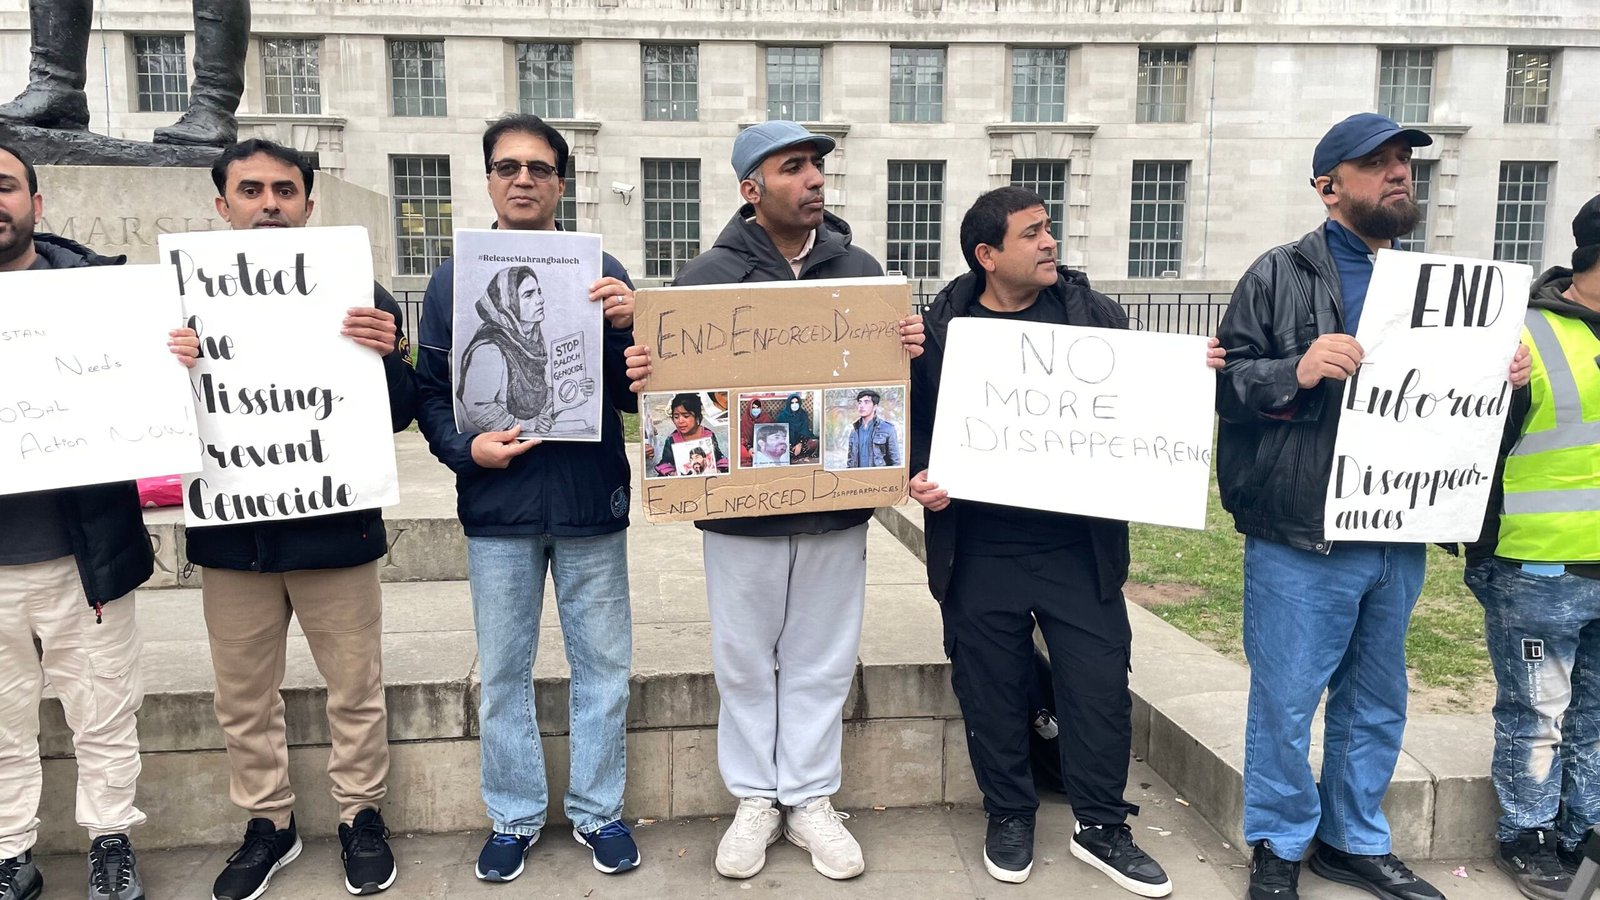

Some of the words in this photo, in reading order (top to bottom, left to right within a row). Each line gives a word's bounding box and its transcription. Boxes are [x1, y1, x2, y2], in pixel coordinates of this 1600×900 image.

[39, 216, 219, 246] MARSH
[169, 249, 317, 298] Protect
[478, 254, 580, 265] #ReleaseMahrangbaloch
[1410, 263, 1504, 328] END
[0, 329, 47, 341] STAN
[186, 315, 236, 360] he
[555, 339, 580, 357] STOP
[655, 309, 728, 360] END
[730, 305, 833, 356] ENFORCED
[54, 353, 123, 376] Needs
[553, 353, 581, 369] BALOCH
[553, 363, 584, 381] GENOCIDE
[1020, 329, 1116, 385] NO
[0, 400, 70, 423] OBAL
[985, 380, 1119, 419] MORE
[1345, 362, 1508, 423] Enforced
[20, 432, 88, 460] Action
[199, 429, 330, 469] revent
[188, 475, 358, 522] Genocide
[646, 484, 699, 516] END
[704, 475, 807, 516] ENFORCED
[1334, 455, 1489, 510] Disappear-
[1335, 508, 1406, 531] ances
